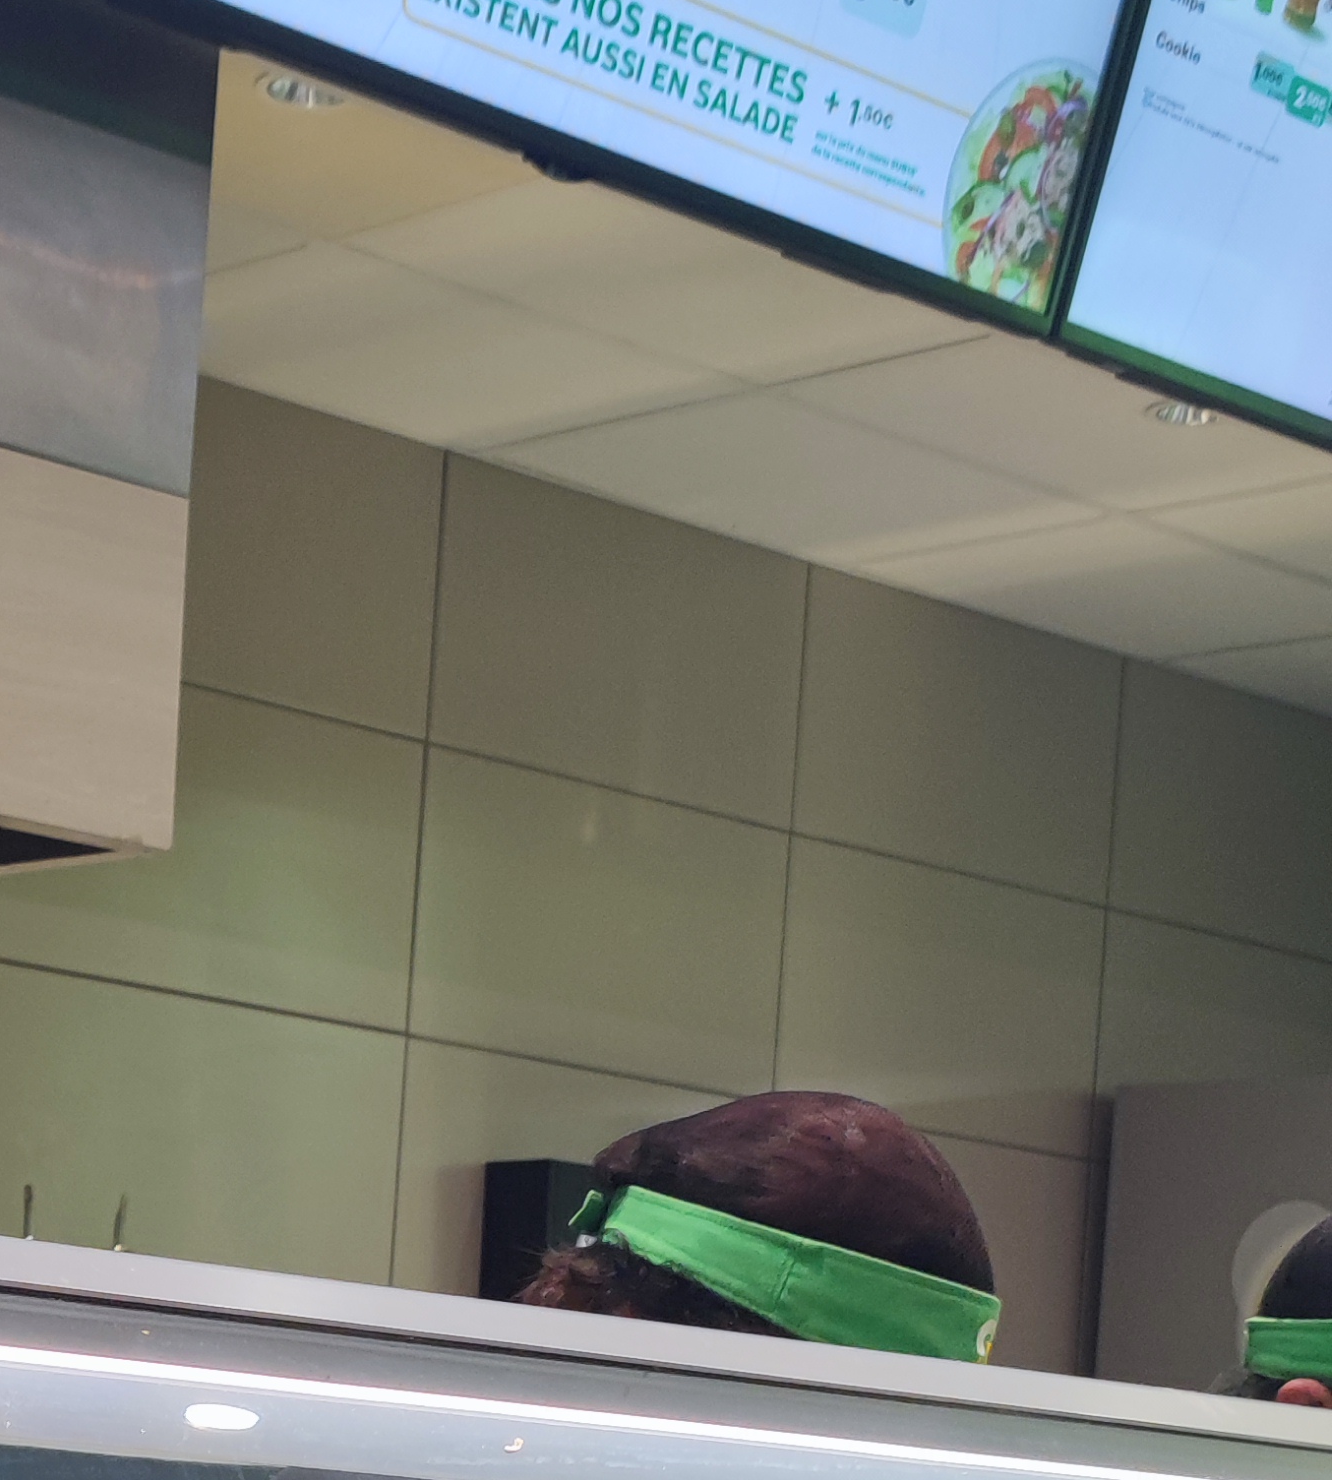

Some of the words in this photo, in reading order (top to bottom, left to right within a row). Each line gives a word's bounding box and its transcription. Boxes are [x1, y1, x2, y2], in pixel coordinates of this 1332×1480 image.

[649, 13, 808, 106] RECETTES
[1155, 32, 1201, 64] Cookie
[561, 29, 646, 82] AUSSI
[650, 62, 689, 101] EN
[693, 79, 798, 145] SALADE
[825, 89, 839, 114] +
